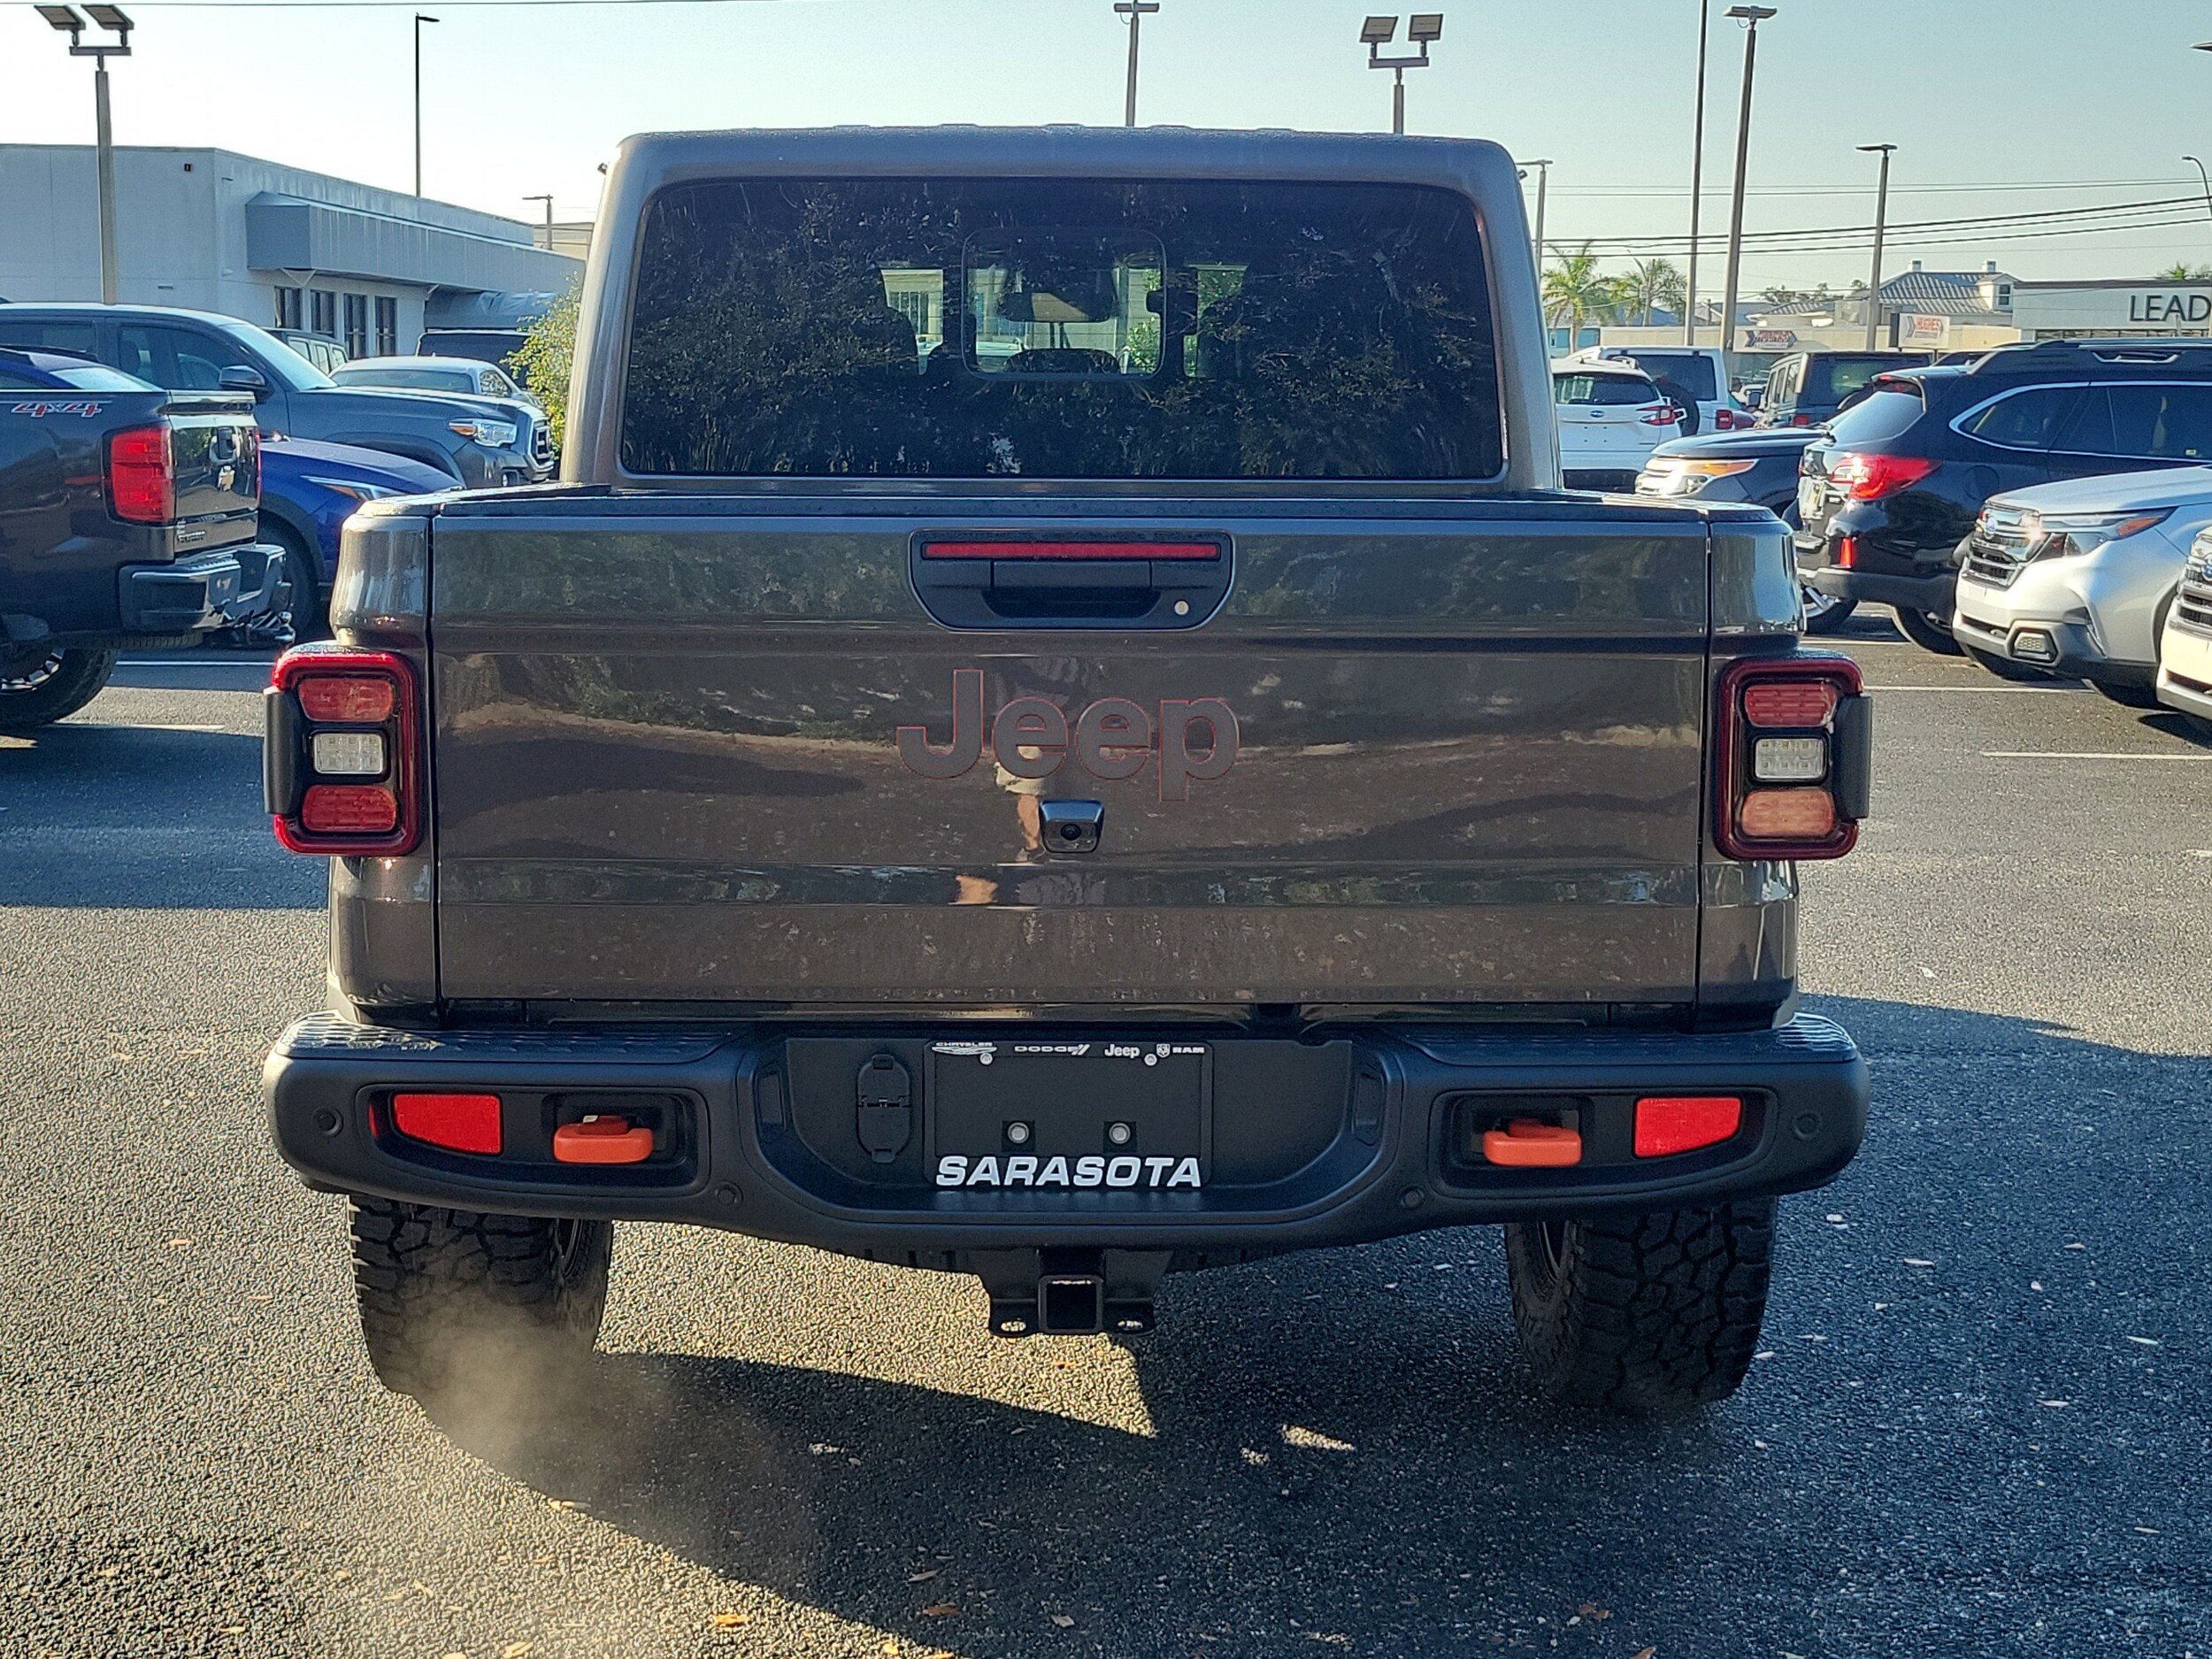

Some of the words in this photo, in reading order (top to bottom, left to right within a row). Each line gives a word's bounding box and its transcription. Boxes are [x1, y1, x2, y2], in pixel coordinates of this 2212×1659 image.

[2130, 295, 2211, 322] LEAD
[896, 669, 1240, 803] Jeep
[1104, 1044, 1141, 1059] Jeep
[936, 1156, 1202, 1187] SARASOTA
